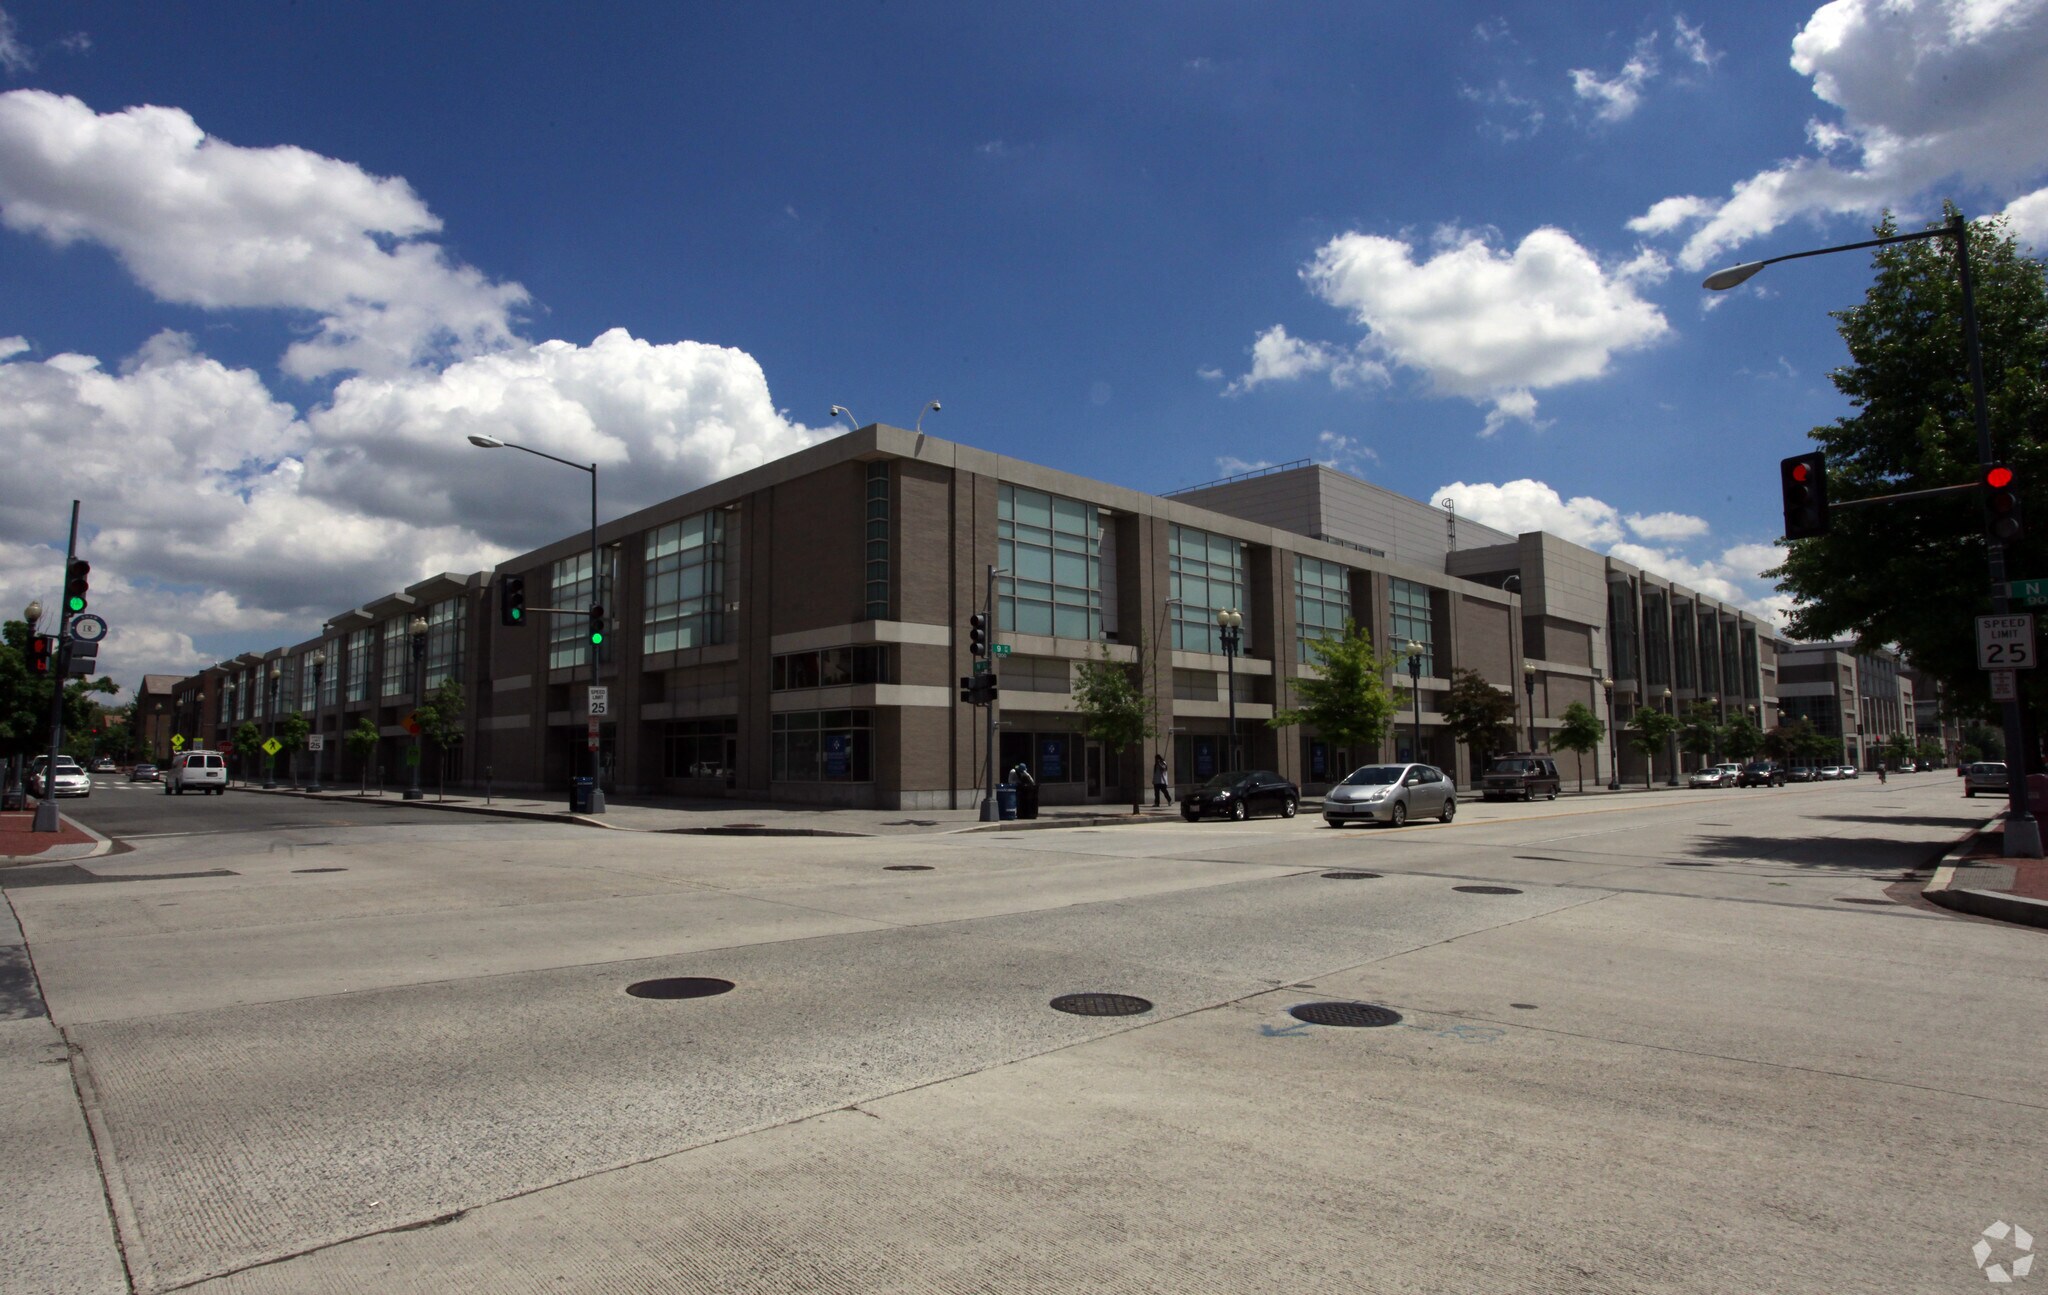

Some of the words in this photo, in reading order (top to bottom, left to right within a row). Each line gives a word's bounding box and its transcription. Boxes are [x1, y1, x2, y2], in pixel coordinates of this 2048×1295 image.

[2025, 582, 2040, 595] N
[1983, 618, 2025, 629] SPEED
[1991, 630, 2018, 639] LIMIT
[1986, 643, 2026, 664] 25
[591, 702, 605, 713] 25
